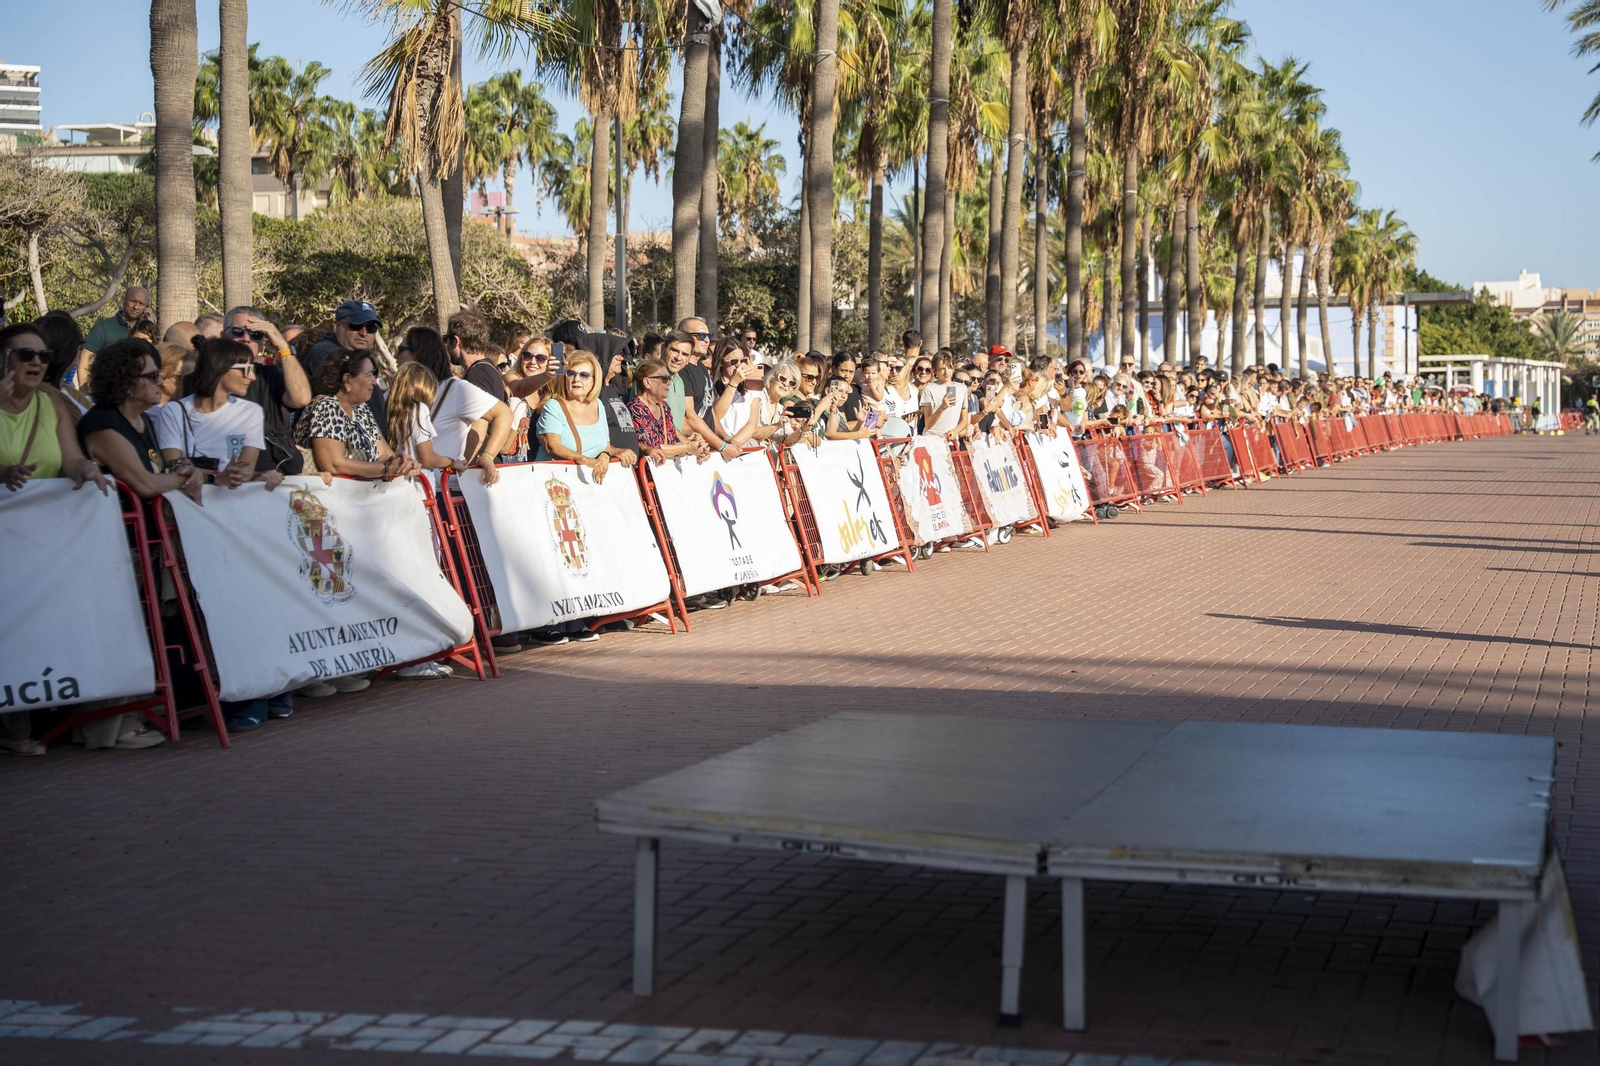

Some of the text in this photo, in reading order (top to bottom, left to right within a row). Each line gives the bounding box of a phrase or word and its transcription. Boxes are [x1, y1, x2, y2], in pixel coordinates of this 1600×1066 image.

[288, 616, 398, 654] AYUNTAMIENTO
[308, 642, 396, 678] DE ALMERÍA
